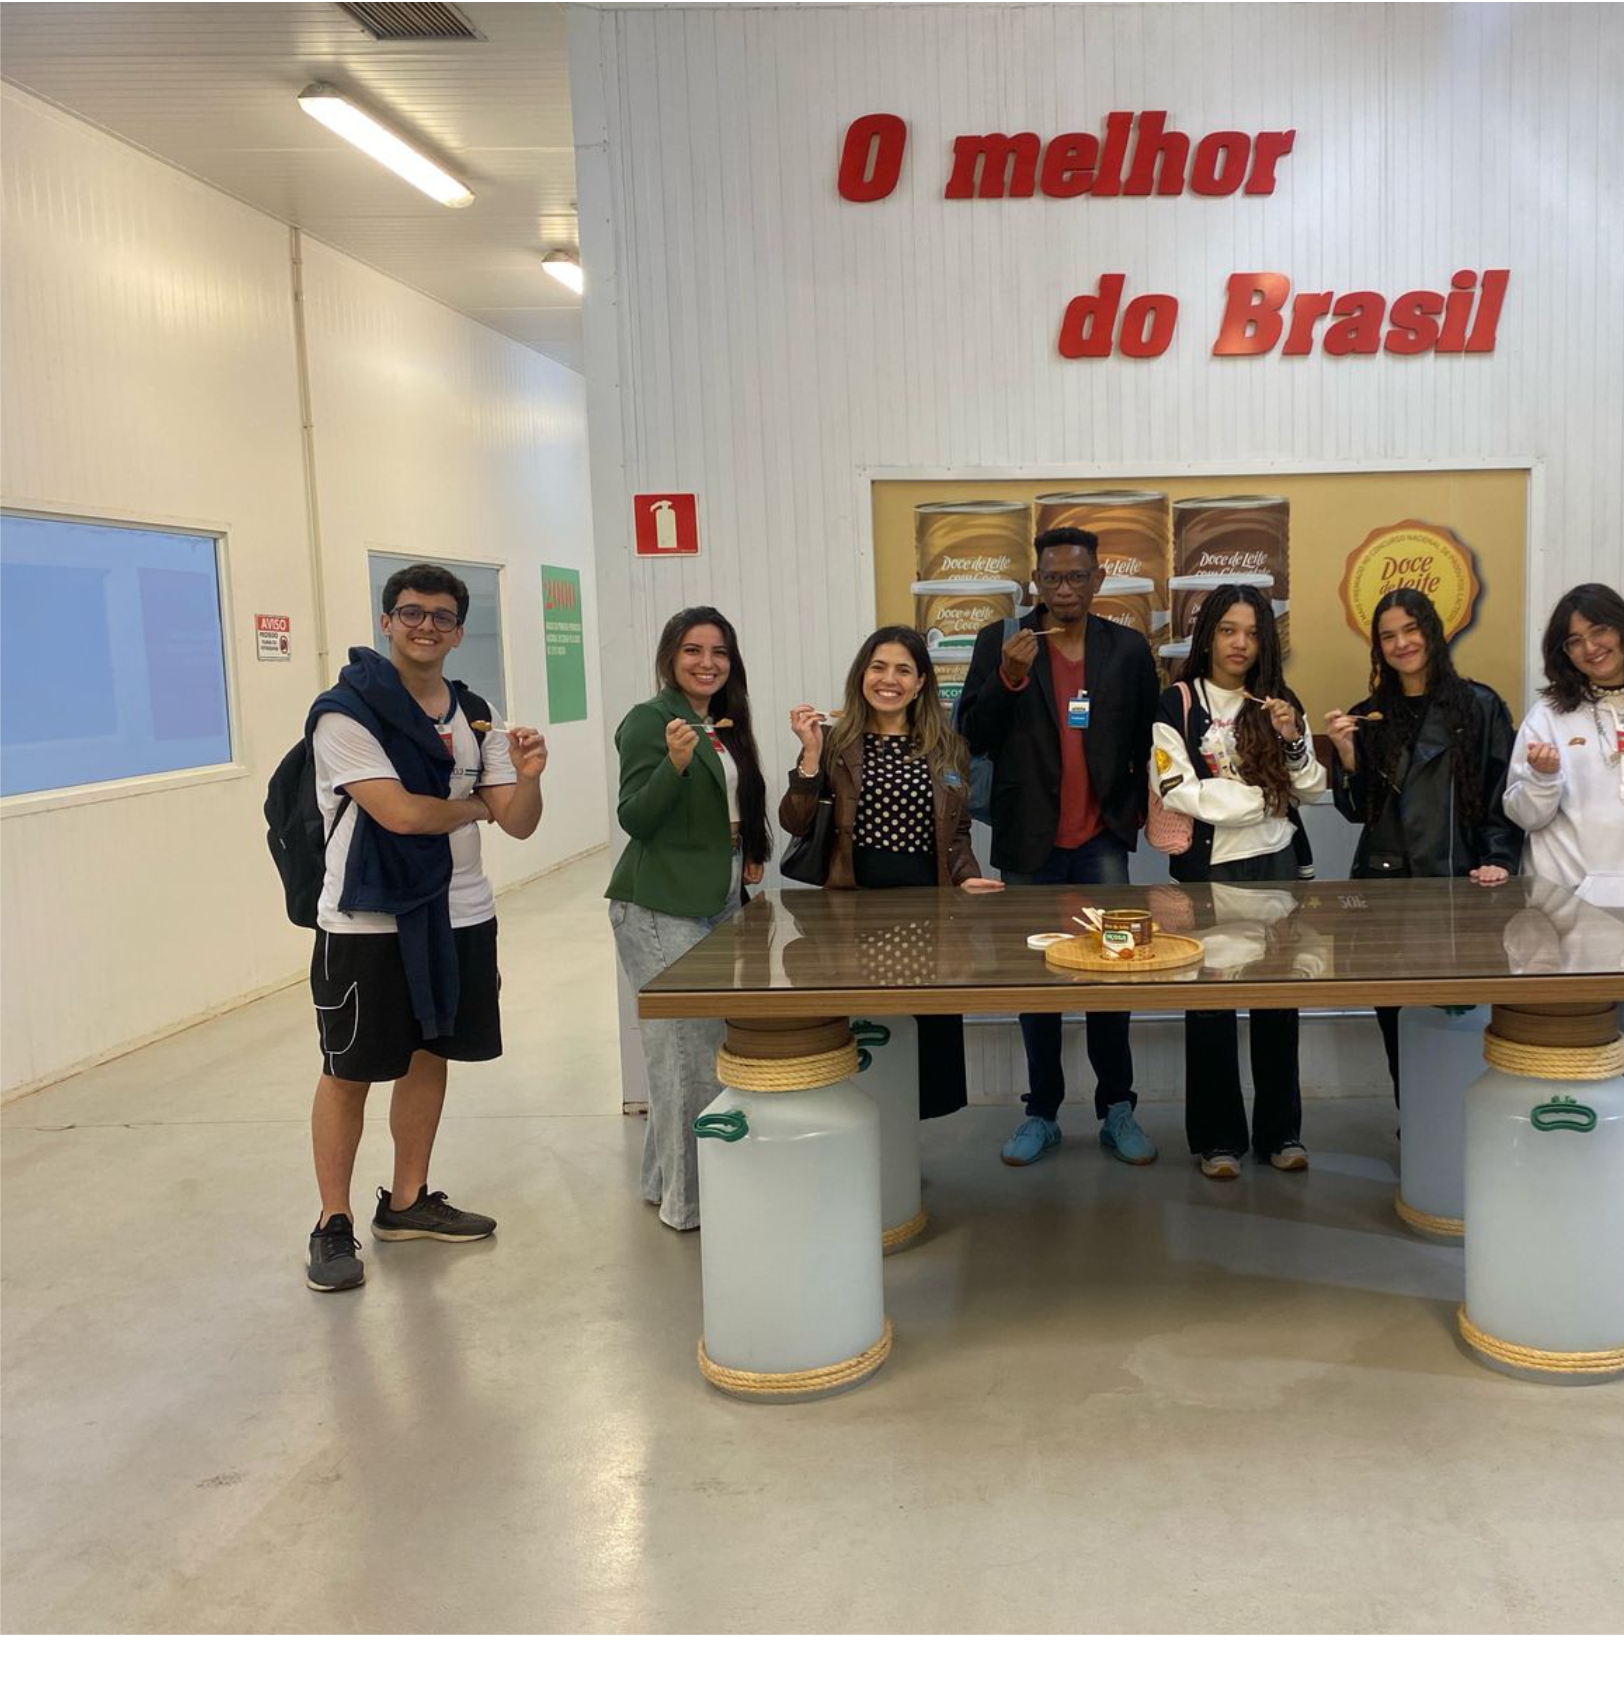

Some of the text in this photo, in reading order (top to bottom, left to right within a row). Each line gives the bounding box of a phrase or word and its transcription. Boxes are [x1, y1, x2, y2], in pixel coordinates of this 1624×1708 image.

[837, 110, 1296, 203] O melhor
[1058, 268, 1511, 358] do Brasil
[941, 554, 1012, 574] Doce de Leite
[1111, 557, 1142, 578] Leite
[1200, 550, 1268, 569] Doce de Leite
[1381, 555, 1434, 581] Doce
[937, 605, 995, 623] Doce Leite
[954, 618, 981, 632] Coco
